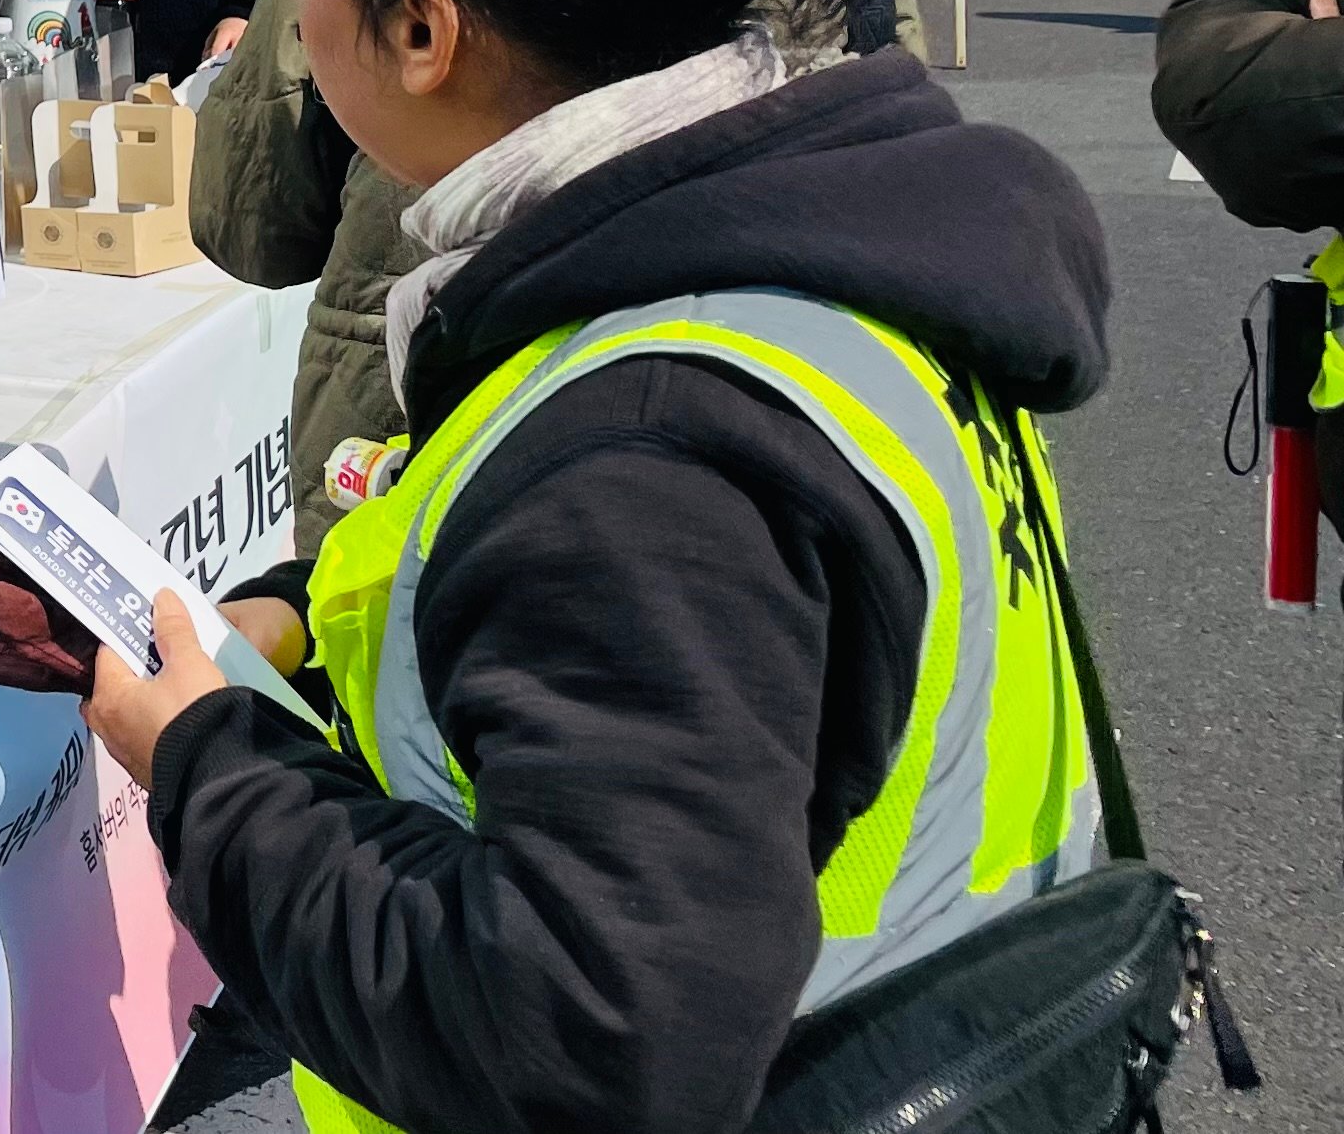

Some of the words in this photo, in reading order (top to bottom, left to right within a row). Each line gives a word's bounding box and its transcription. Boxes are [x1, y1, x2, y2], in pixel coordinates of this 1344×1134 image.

[32, 545, 67, 582] DOKDO
[67, 576, 78, 590] IS
[77, 586, 118, 628] KOREAN
[46, 524, 112, 595] 독도는
[79, 789, 129, 874] 홈서버의
